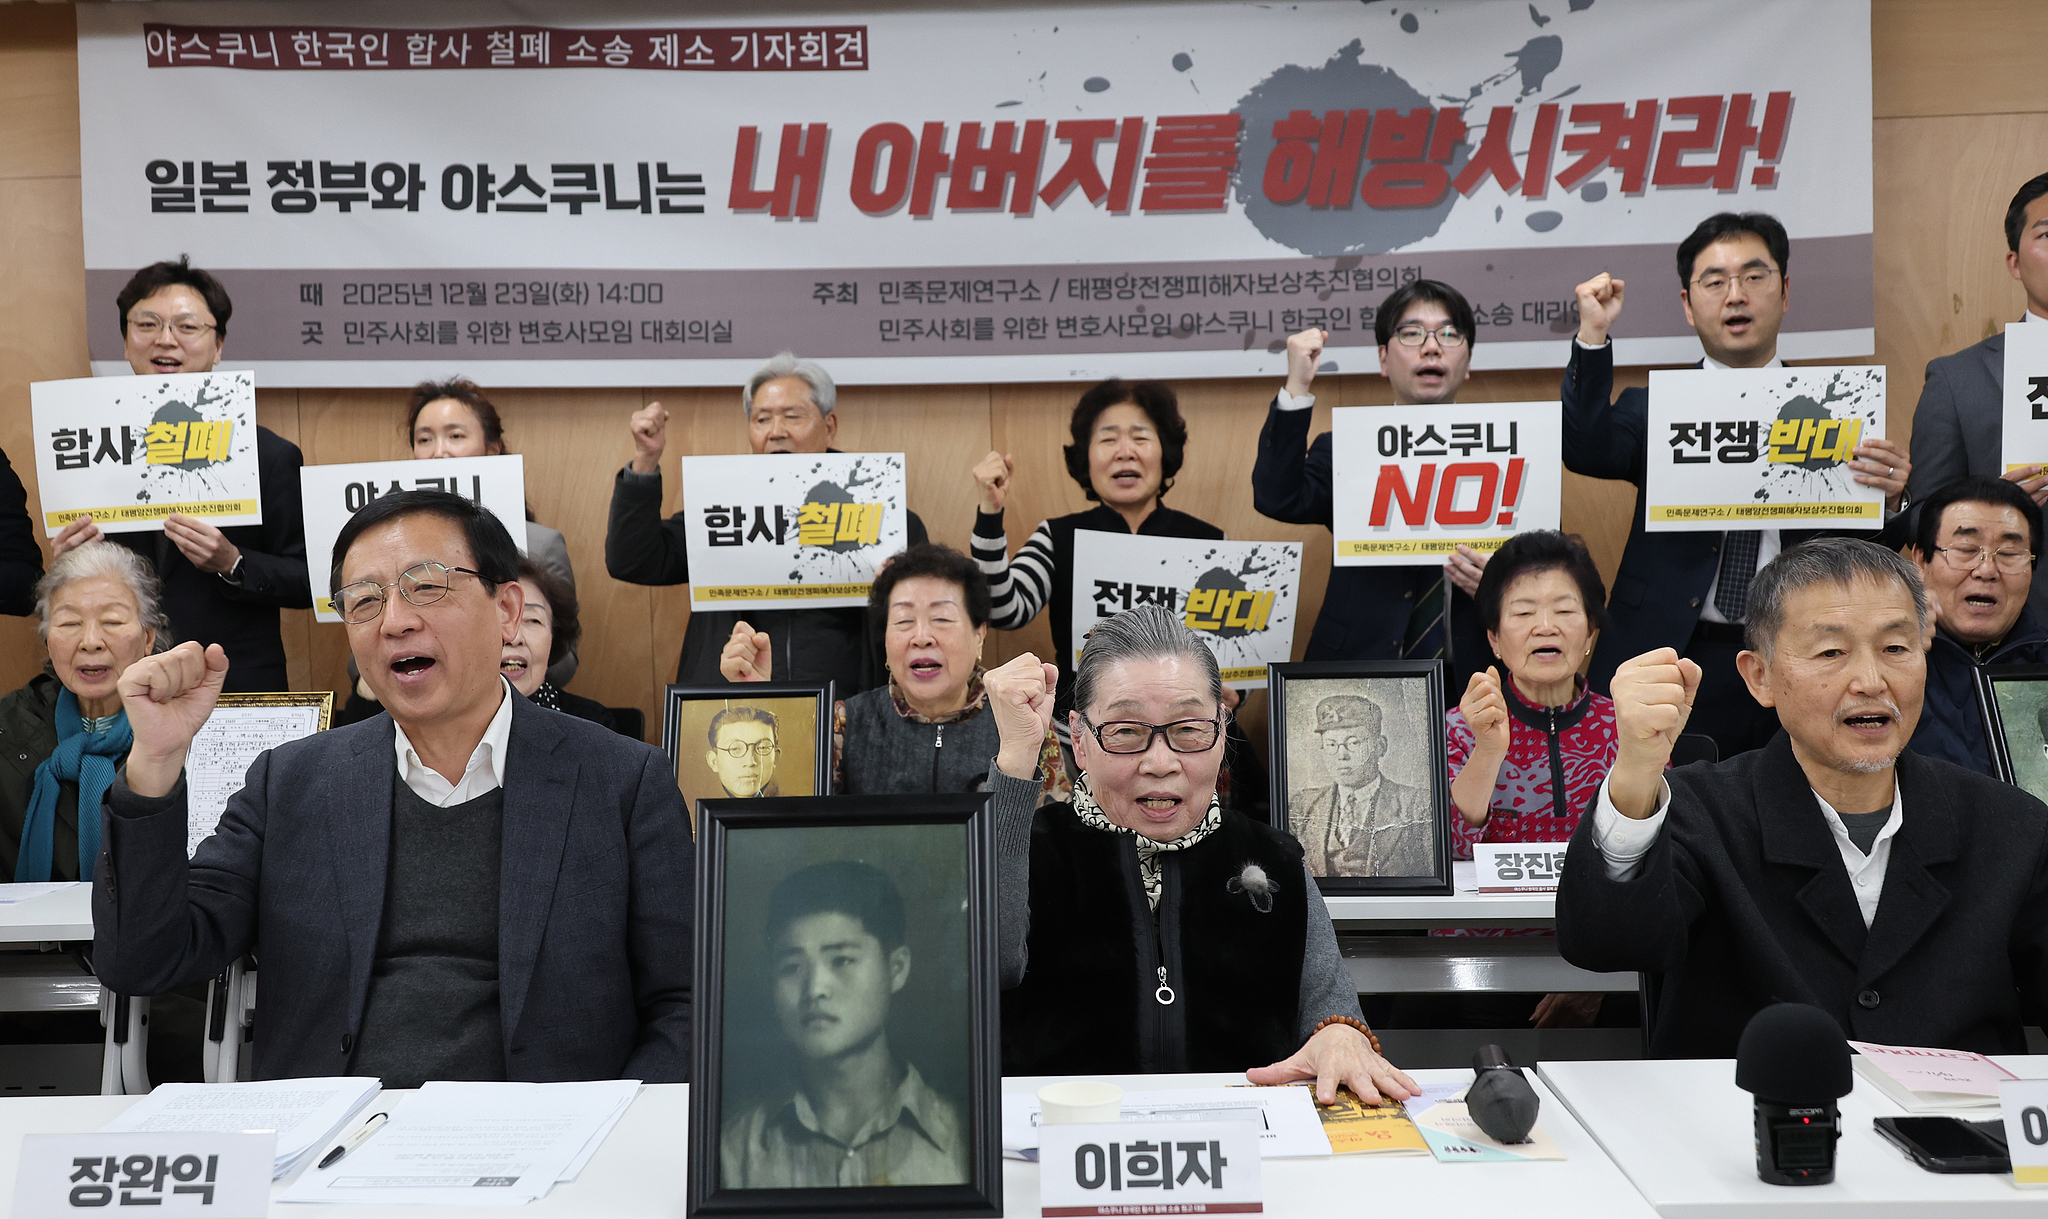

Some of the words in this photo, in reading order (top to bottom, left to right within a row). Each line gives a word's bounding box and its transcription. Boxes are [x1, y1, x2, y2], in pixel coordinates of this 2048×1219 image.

[147, 29, 281, 66] 야스쿠니
[292, 31, 389, 67] 한국인
[406, 32, 471, 67] 합사
[486, 33, 550, 66] 철폐
[566, 34, 633, 66] 소송
[649, 33, 714, 67] 제소
[730, 31, 865, 68] 기자회견
[145, 160, 251, 214] 일본
[266, 160, 426, 214] 정부와
[441, 162, 706, 215] 야스쿠니는
[728, 122, 832, 221] 내
[850, 115, 1243, 219] 아버지를
[1261, 91, 1794, 212] 해방시켜라!
[300, 281, 324, 306] 때
[343, 282, 432, 306] 2025년
[440, 282, 487, 306] 12월
[495, 282, 589, 306] 23일(화)
[597, 282, 663, 304] 14:00
[812, 281, 858, 306] 주최
[879, 278, 1042, 305] 민족문제연구소
[1050, 277, 1060, 302] /
[300, 321, 324, 346] 곳
[343, 320, 458, 346] 민주사회를
[467, 320, 511, 346] 위한
[518, 320, 633, 345] 변호사모임
[641, 320, 733, 345] 대회의실
[879, 317, 995, 343] 민주사회를
[1002, 316, 1048, 341] 위한
[1056, 312, 1172, 340] 변호사모임
[1180, 308, 1274, 335] 야스쿠니
[1281, 306, 1350, 334] 한국인
[51, 425, 136, 470] 합사
[144, 420, 235, 464] 철폐
[1377, 421, 1518, 458] 야스쿠니
[1668, 420, 1759, 464] 전쟁
[1767, 418, 1864, 463] 반대
[1369, 457, 1529, 531] NO!
[1666, 507, 1725, 518] 민족문제연구소
[1735, 504, 1863, 517] 태평양전쟁피해자보상추진협의회
[703, 504, 789, 546] 합사
[797, 502, 885, 545] 철폐
[1353, 542, 1410, 553] 민족문제연구소
[708, 587, 763, 598] 민족문제연구소
[1184, 588, 1277, 631] 반대
[1788, 1107, 1825, 1116] ZOOM
[68, 1152, 218, 1208] 장완익
[1074, 1140, 1228, 1191] 이희자
